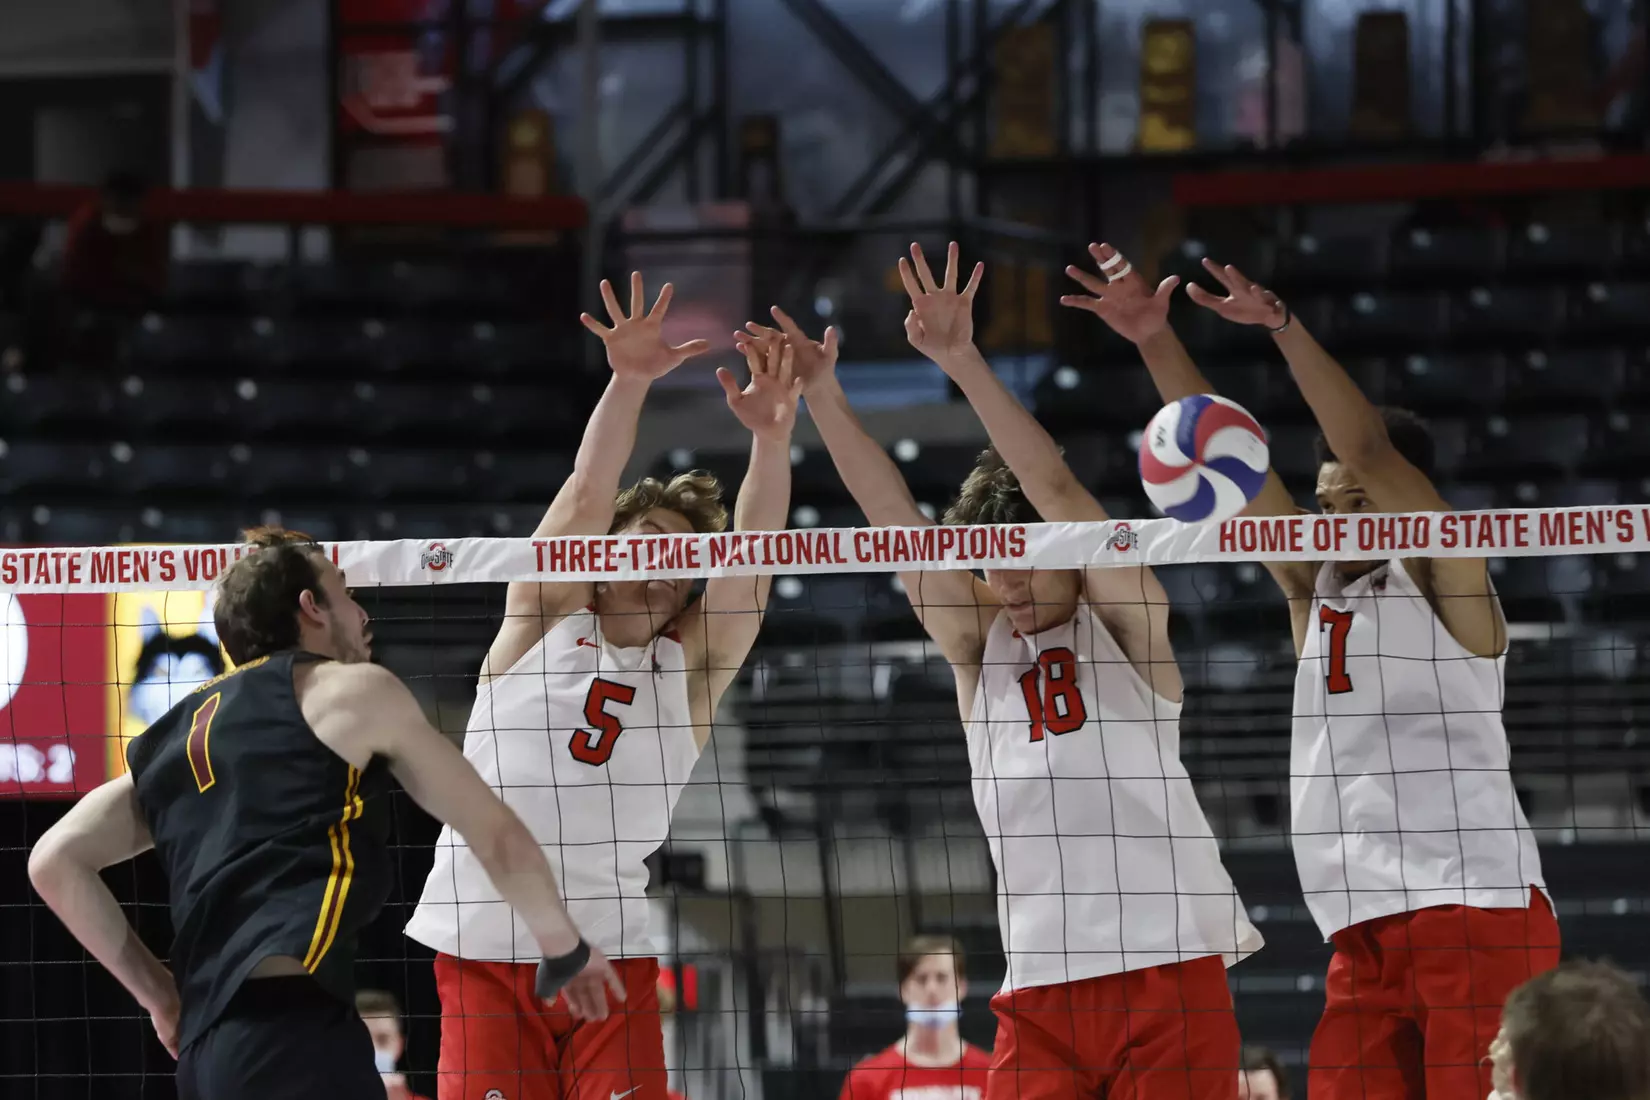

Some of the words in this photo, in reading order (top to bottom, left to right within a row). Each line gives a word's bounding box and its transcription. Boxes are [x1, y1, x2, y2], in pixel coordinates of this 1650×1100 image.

[2, 552, 82, 585] STATE
[90, 550, 176, 585] MEN'S
[532, 537, 701, 573] THREE-TIME
[709, 532, 848, 568] NATIONAL
[853, 526, 1026, 563] CHAMPIONS
[1220, 519, 1303, 553] HOME
[1313, 518, 1346, 552] OF
[1358, 516, 1430, 551] OHIO
[1440, 513, 1529, 548] STATE
[1539, 507, 1636, 547] MEN'S
[1319, 604, 1354, 695] 7
[568, 677, 636, 767] 5
[1016, 647, 1088, 744] 18
[186, 691, 221, 794] 1
